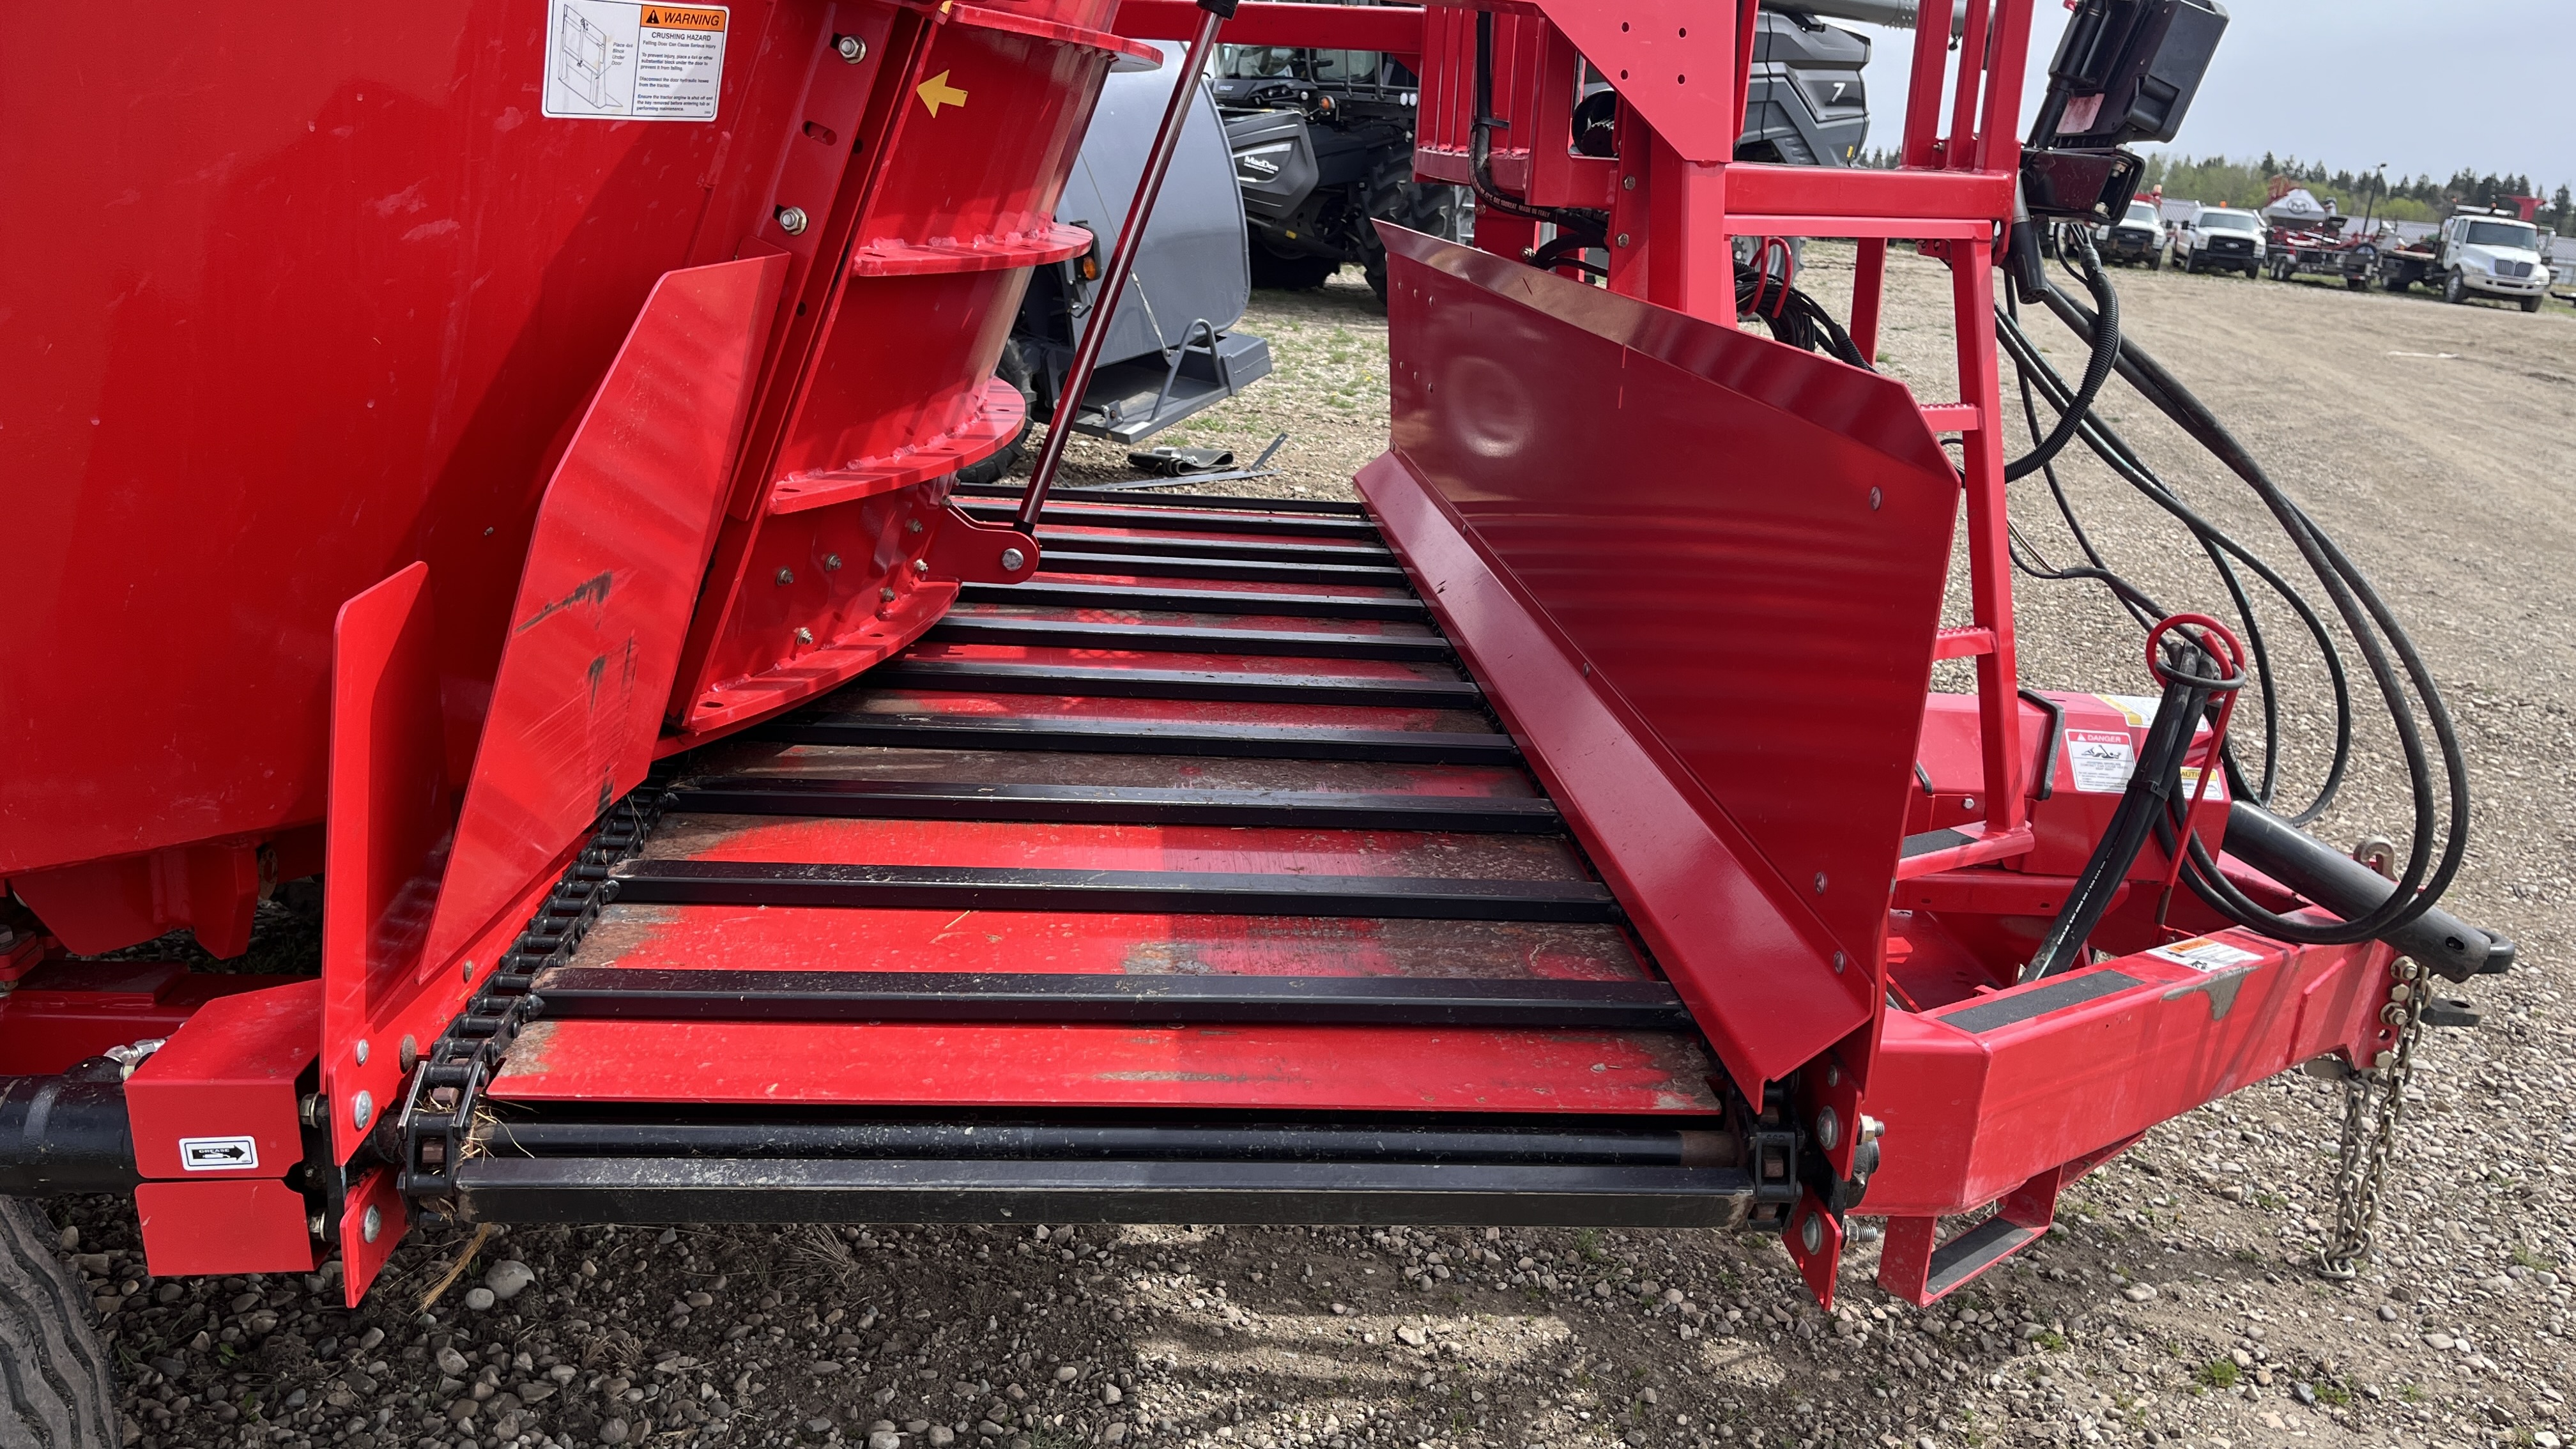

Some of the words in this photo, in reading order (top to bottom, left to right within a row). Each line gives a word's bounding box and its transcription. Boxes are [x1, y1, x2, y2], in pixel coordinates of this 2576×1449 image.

[664, 12, 719, 26] WARNING
[1832, 82, 1846, 102] 7
[1245, 155, 1278, 172] MacDon
[1538, 210, 1551, 218] ITALY
[2087, 734, 2121, 742] DANGER
